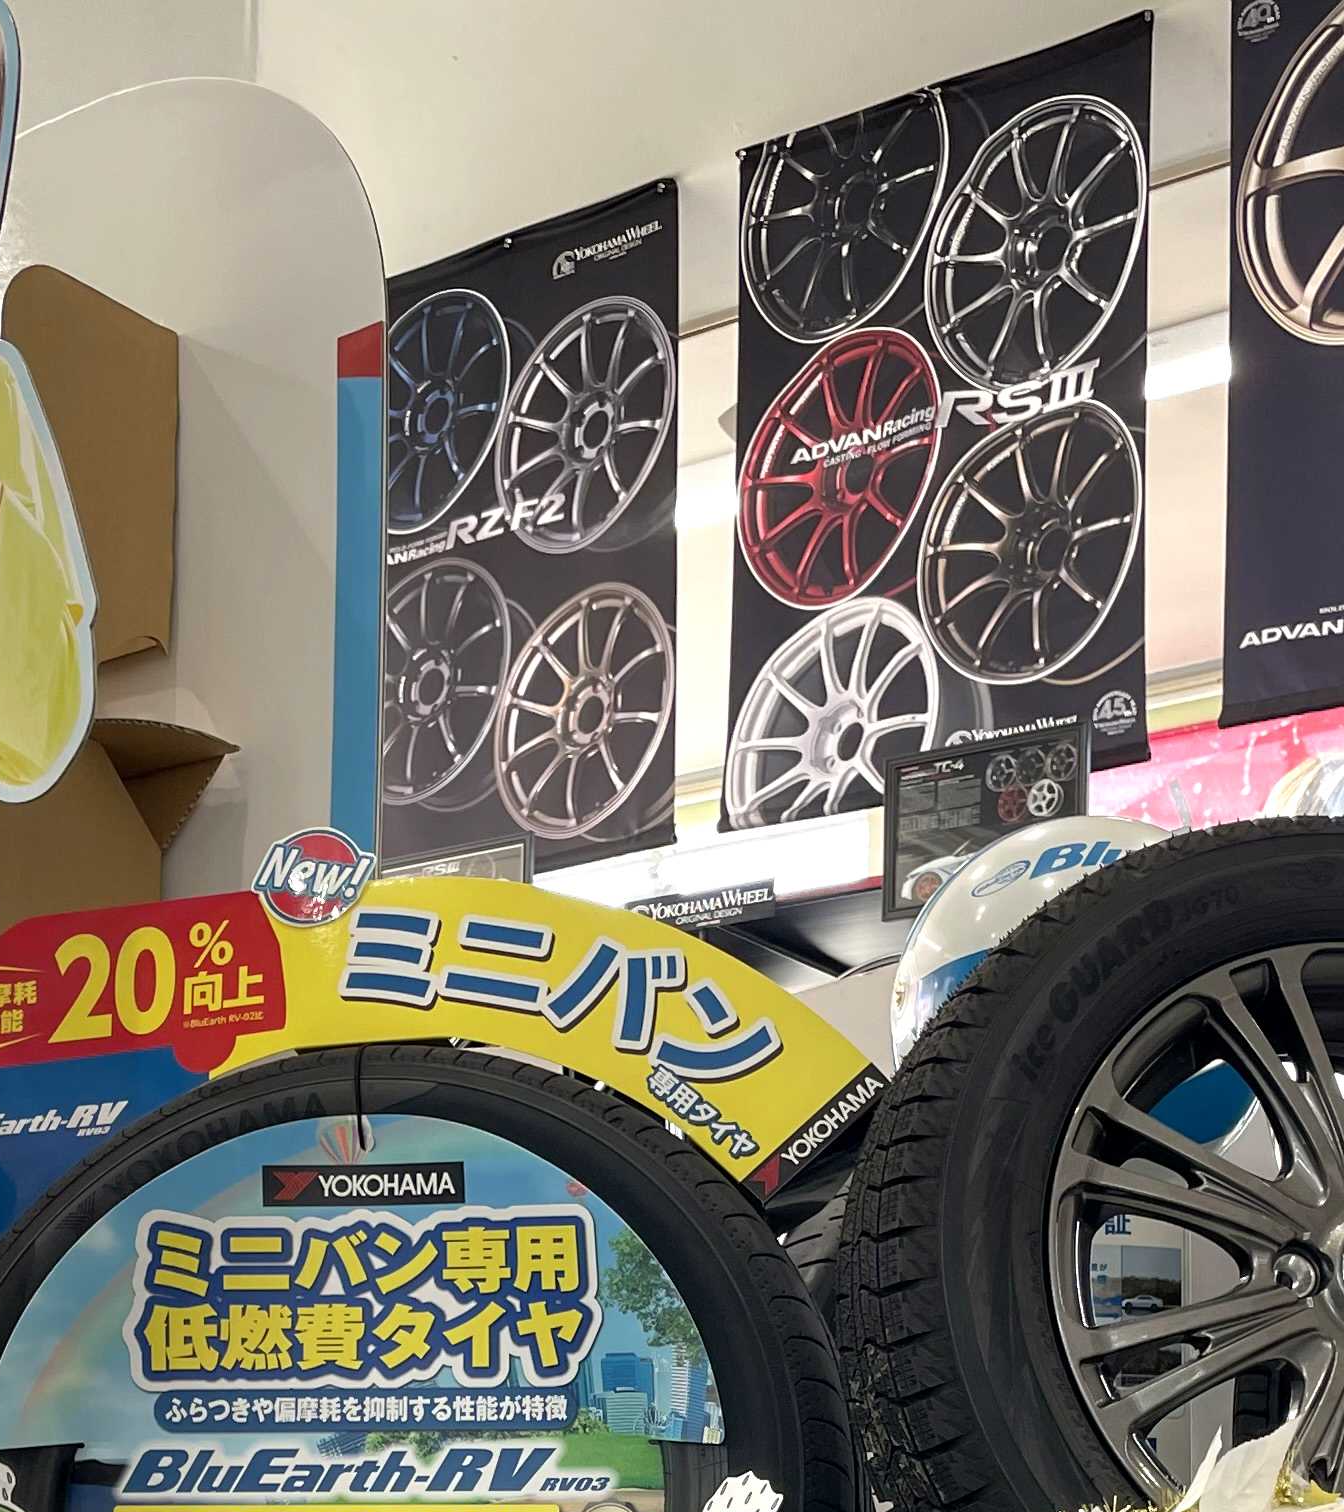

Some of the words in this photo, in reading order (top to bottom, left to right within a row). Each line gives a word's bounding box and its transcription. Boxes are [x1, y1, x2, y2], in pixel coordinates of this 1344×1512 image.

[574, 233, 628, 261] YOKOHAMA
[445, 493, 566, 550] RZ-F2
[258, 847, 371, 898] New!
[649, 897, 722, 922] YOKOHAMA
[721, 886, 774, 910] WHEEL
[183, 965, 265, 1015] 向上
[346, 911, 780, 1074] ミニバン
[648, 1064, 758, 1157] 専用タイヤ
[781, 1076, 885, 1166] YOKOHAMA
[318, 1171, 456, 1199] YOKOHAMA
[153, 1223, 582, 1297] ミニバン専用
[143, 1300, 586, 1372] 低燃費タイヤ
[164, 1394, 569, 1424] ふらつきや偏摩耗を抑制する性能が特徴
[122, 1447, 557, 1495] BluEarth-RV
[541, 1476, 611, 1492] RV03
